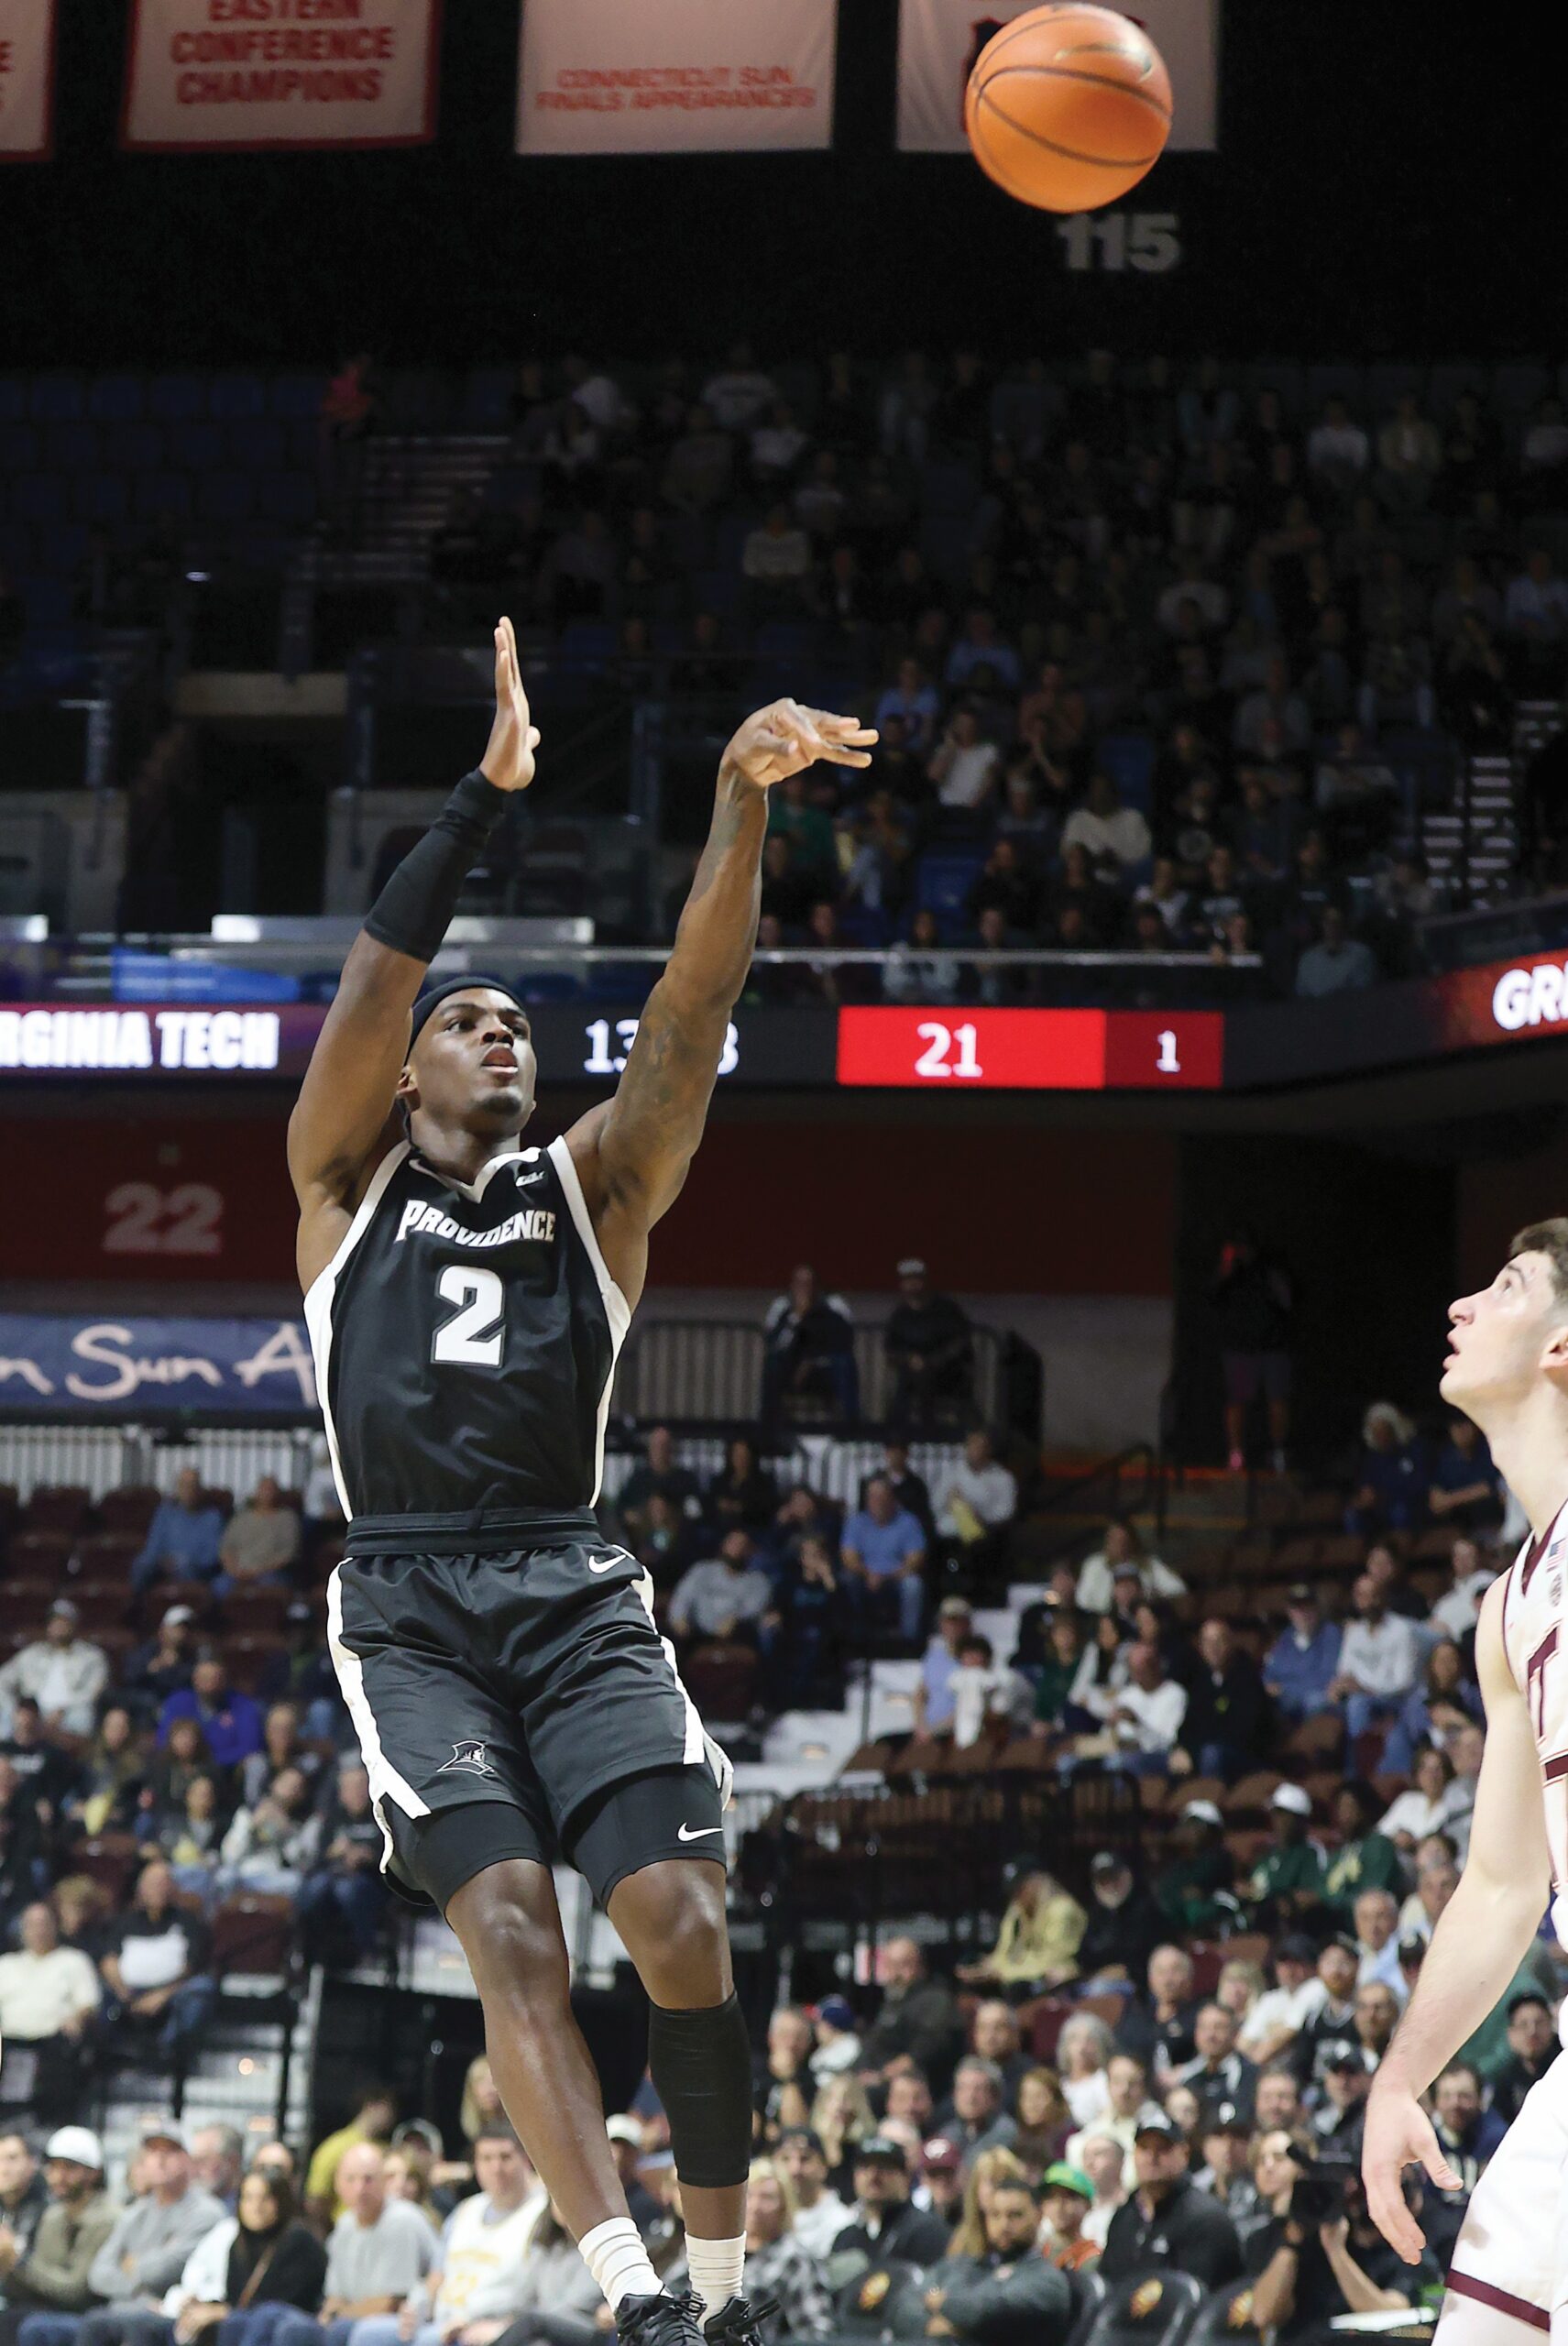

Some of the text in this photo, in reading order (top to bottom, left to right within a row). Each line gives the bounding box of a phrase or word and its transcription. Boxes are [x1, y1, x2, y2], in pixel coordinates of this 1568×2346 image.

[170, 27, 395, 63] CONFERENCE
[177, 69, 381, 104] CHAMPIONS
[1057, 213, 1180, 272] 115
[155, 1011, 280, 1069] TECH
[915, 1022, 983, 1078] 21
[1157, 1029, 1181, 1073] 1
[102, 1182, 224, 1254] 22
[396, 1199, 556, 1247] PROVIDENCE
[431, 1264, 506, 1368] 2
[65, 1323, 224, 1402] Sun
